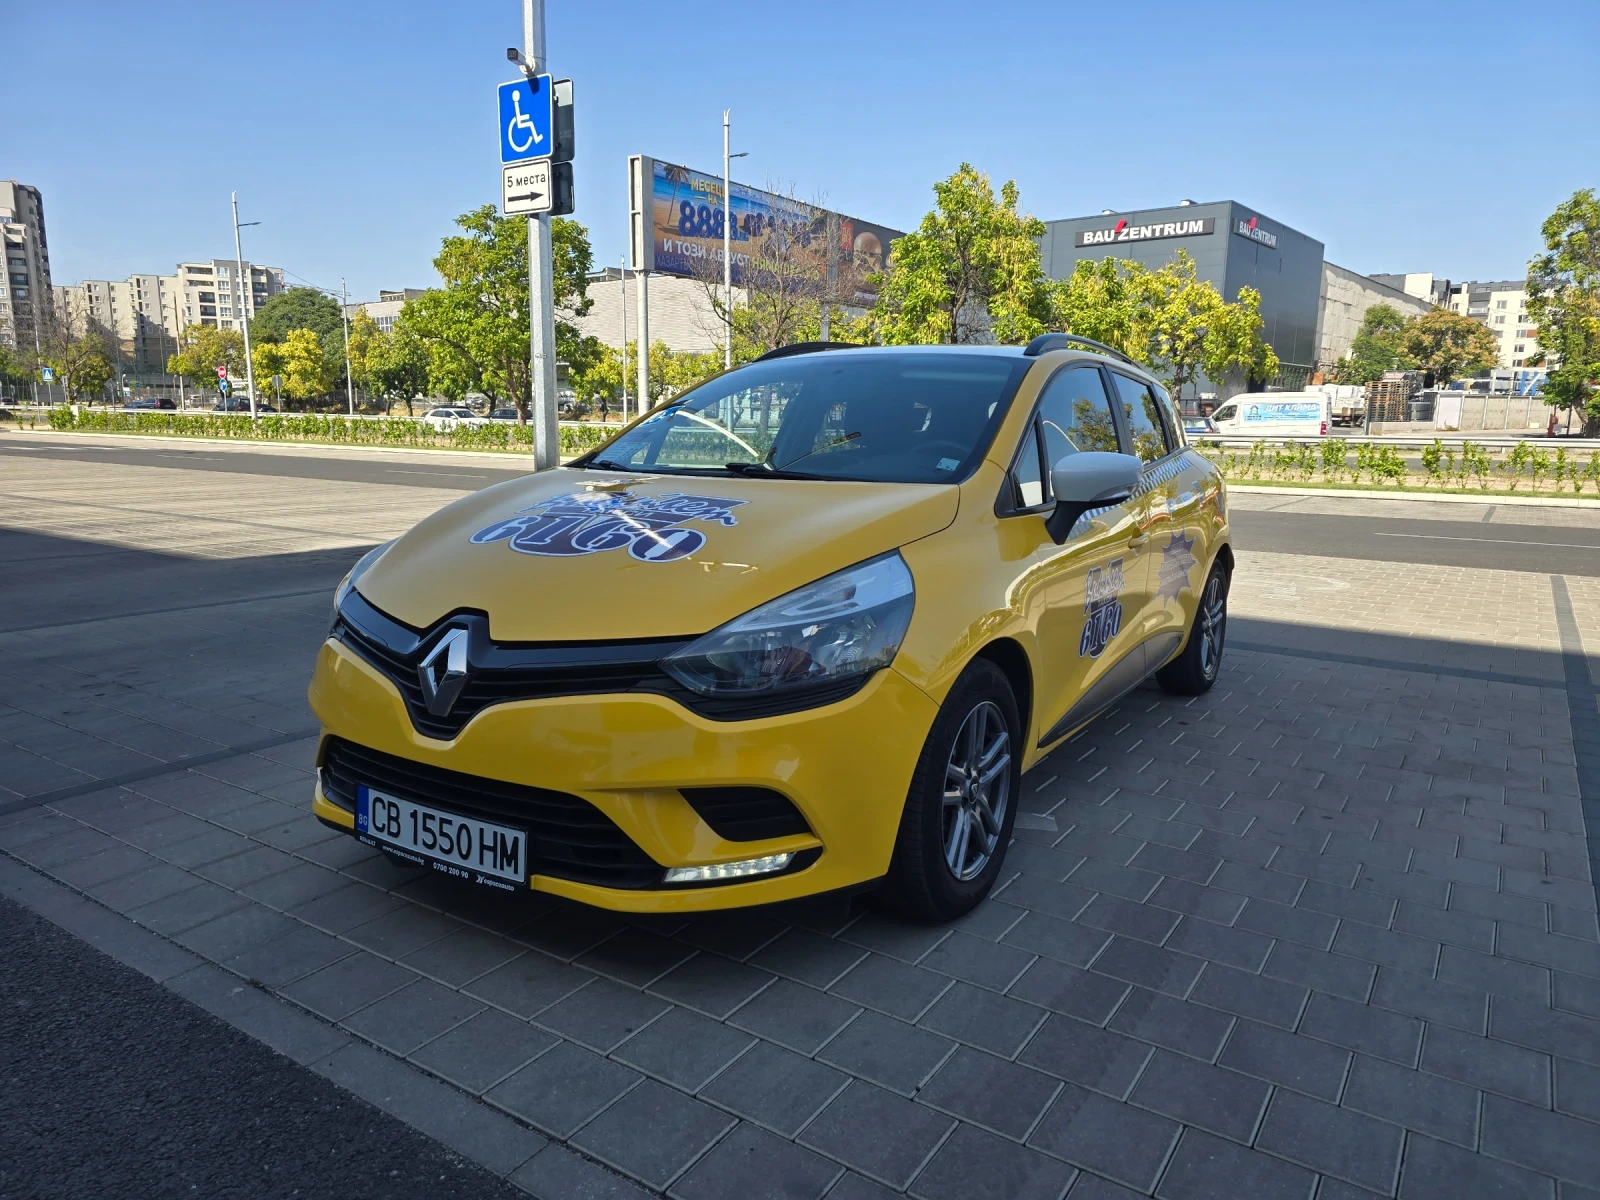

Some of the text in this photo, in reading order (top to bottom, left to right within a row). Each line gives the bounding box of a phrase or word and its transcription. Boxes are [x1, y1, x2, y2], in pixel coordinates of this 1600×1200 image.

[507, 173, 546, 188] 5 места
[707, 194, 718, 205] НА
[663, 238, 750, 266] И ТОЗИ АВУСТ
[468, 515, 708, 563] 6160
[1078, 602, 1123, 658] 6160
[358, 813, 368, 826] BG
[410, 809, 472, 860] 1550
[432, 862, 447, 873] 0700
[448, 867, 460, 877] 200
[460, 870, 469, 879] 90
